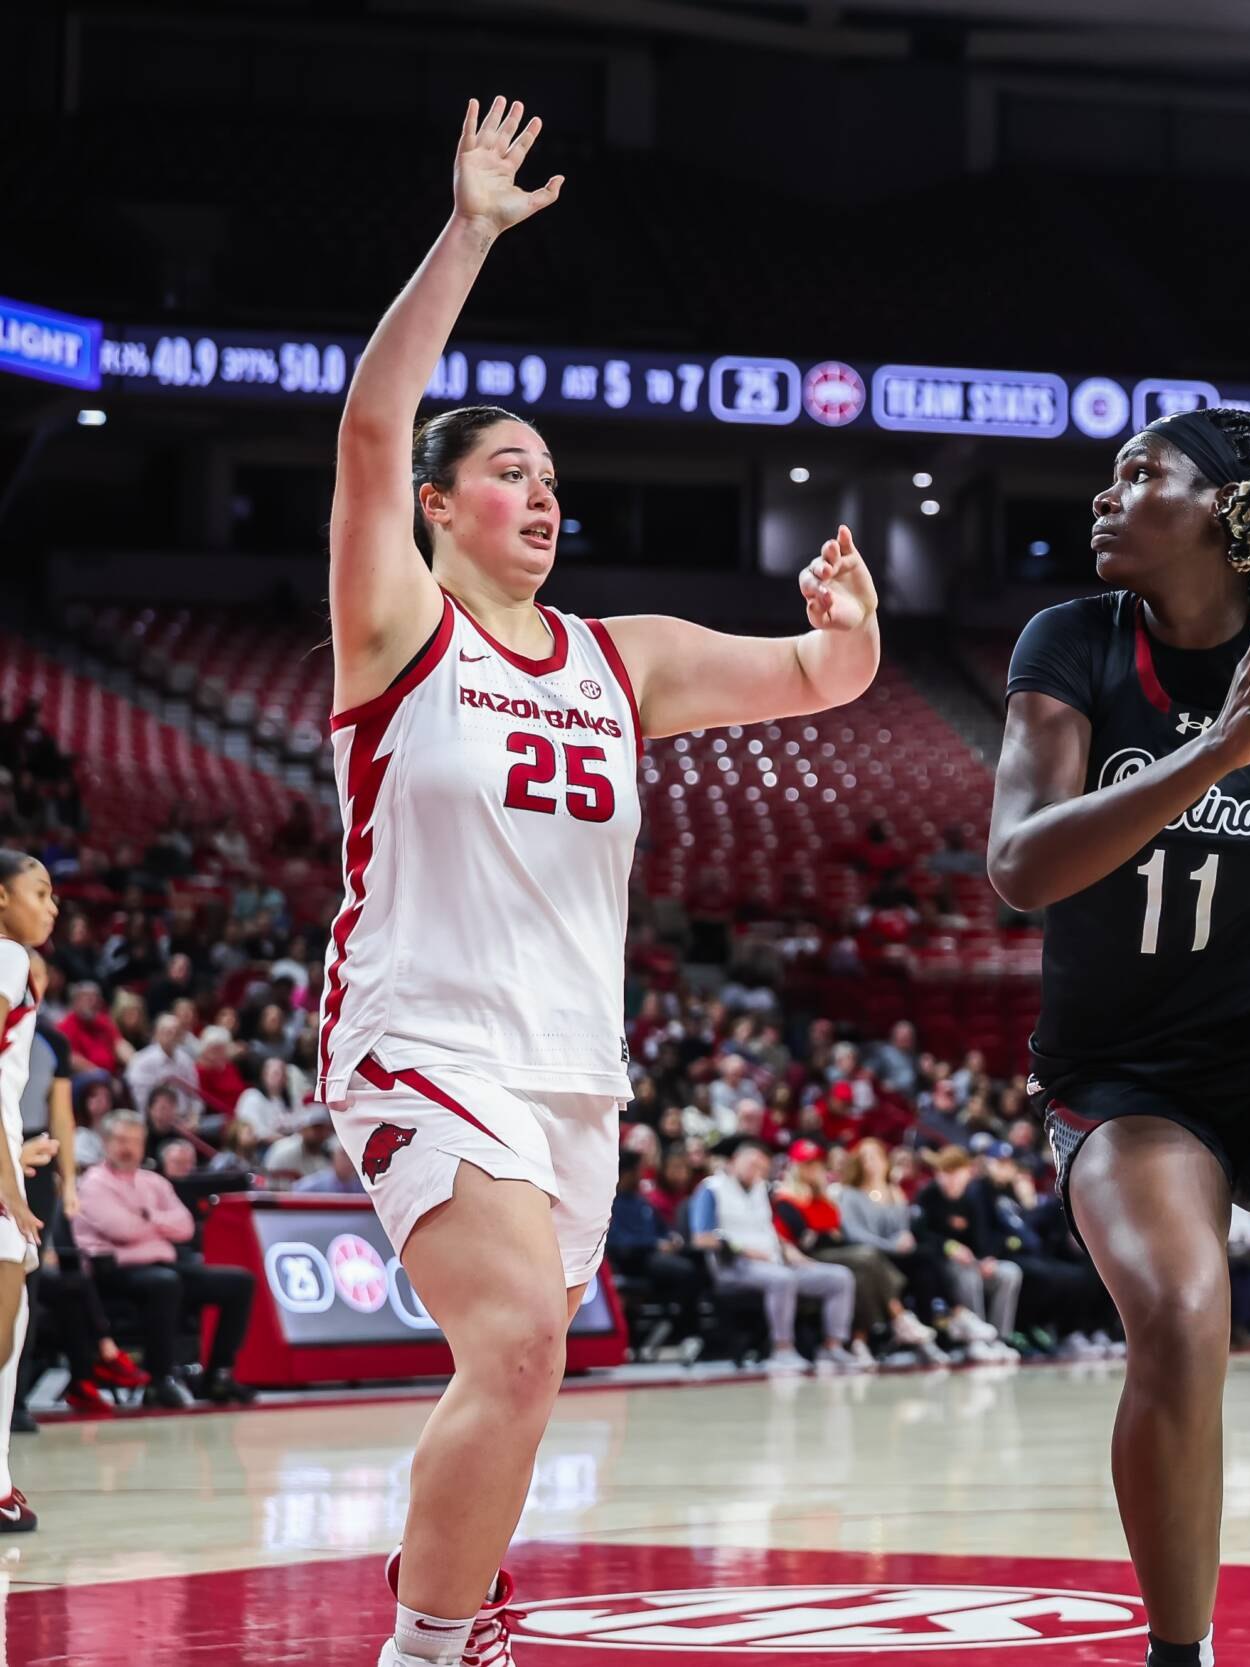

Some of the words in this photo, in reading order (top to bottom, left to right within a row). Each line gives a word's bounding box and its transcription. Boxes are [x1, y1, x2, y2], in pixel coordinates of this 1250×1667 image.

[153, 337, 218, 386] 40.9
[279, 342, 346, 394] 50.0
[519, 354, 547, 404] 9
[604, 360, 631, 408] 5
[677, 363, 704, 412] 7
[886, 378, 964, 420] TEAM
[967, 383, 1056, 428] STATS
[580, 680, 601, 698] SEC
[503, 732, 615, 823] 25
[1137, 848, 1219, 954] 11
